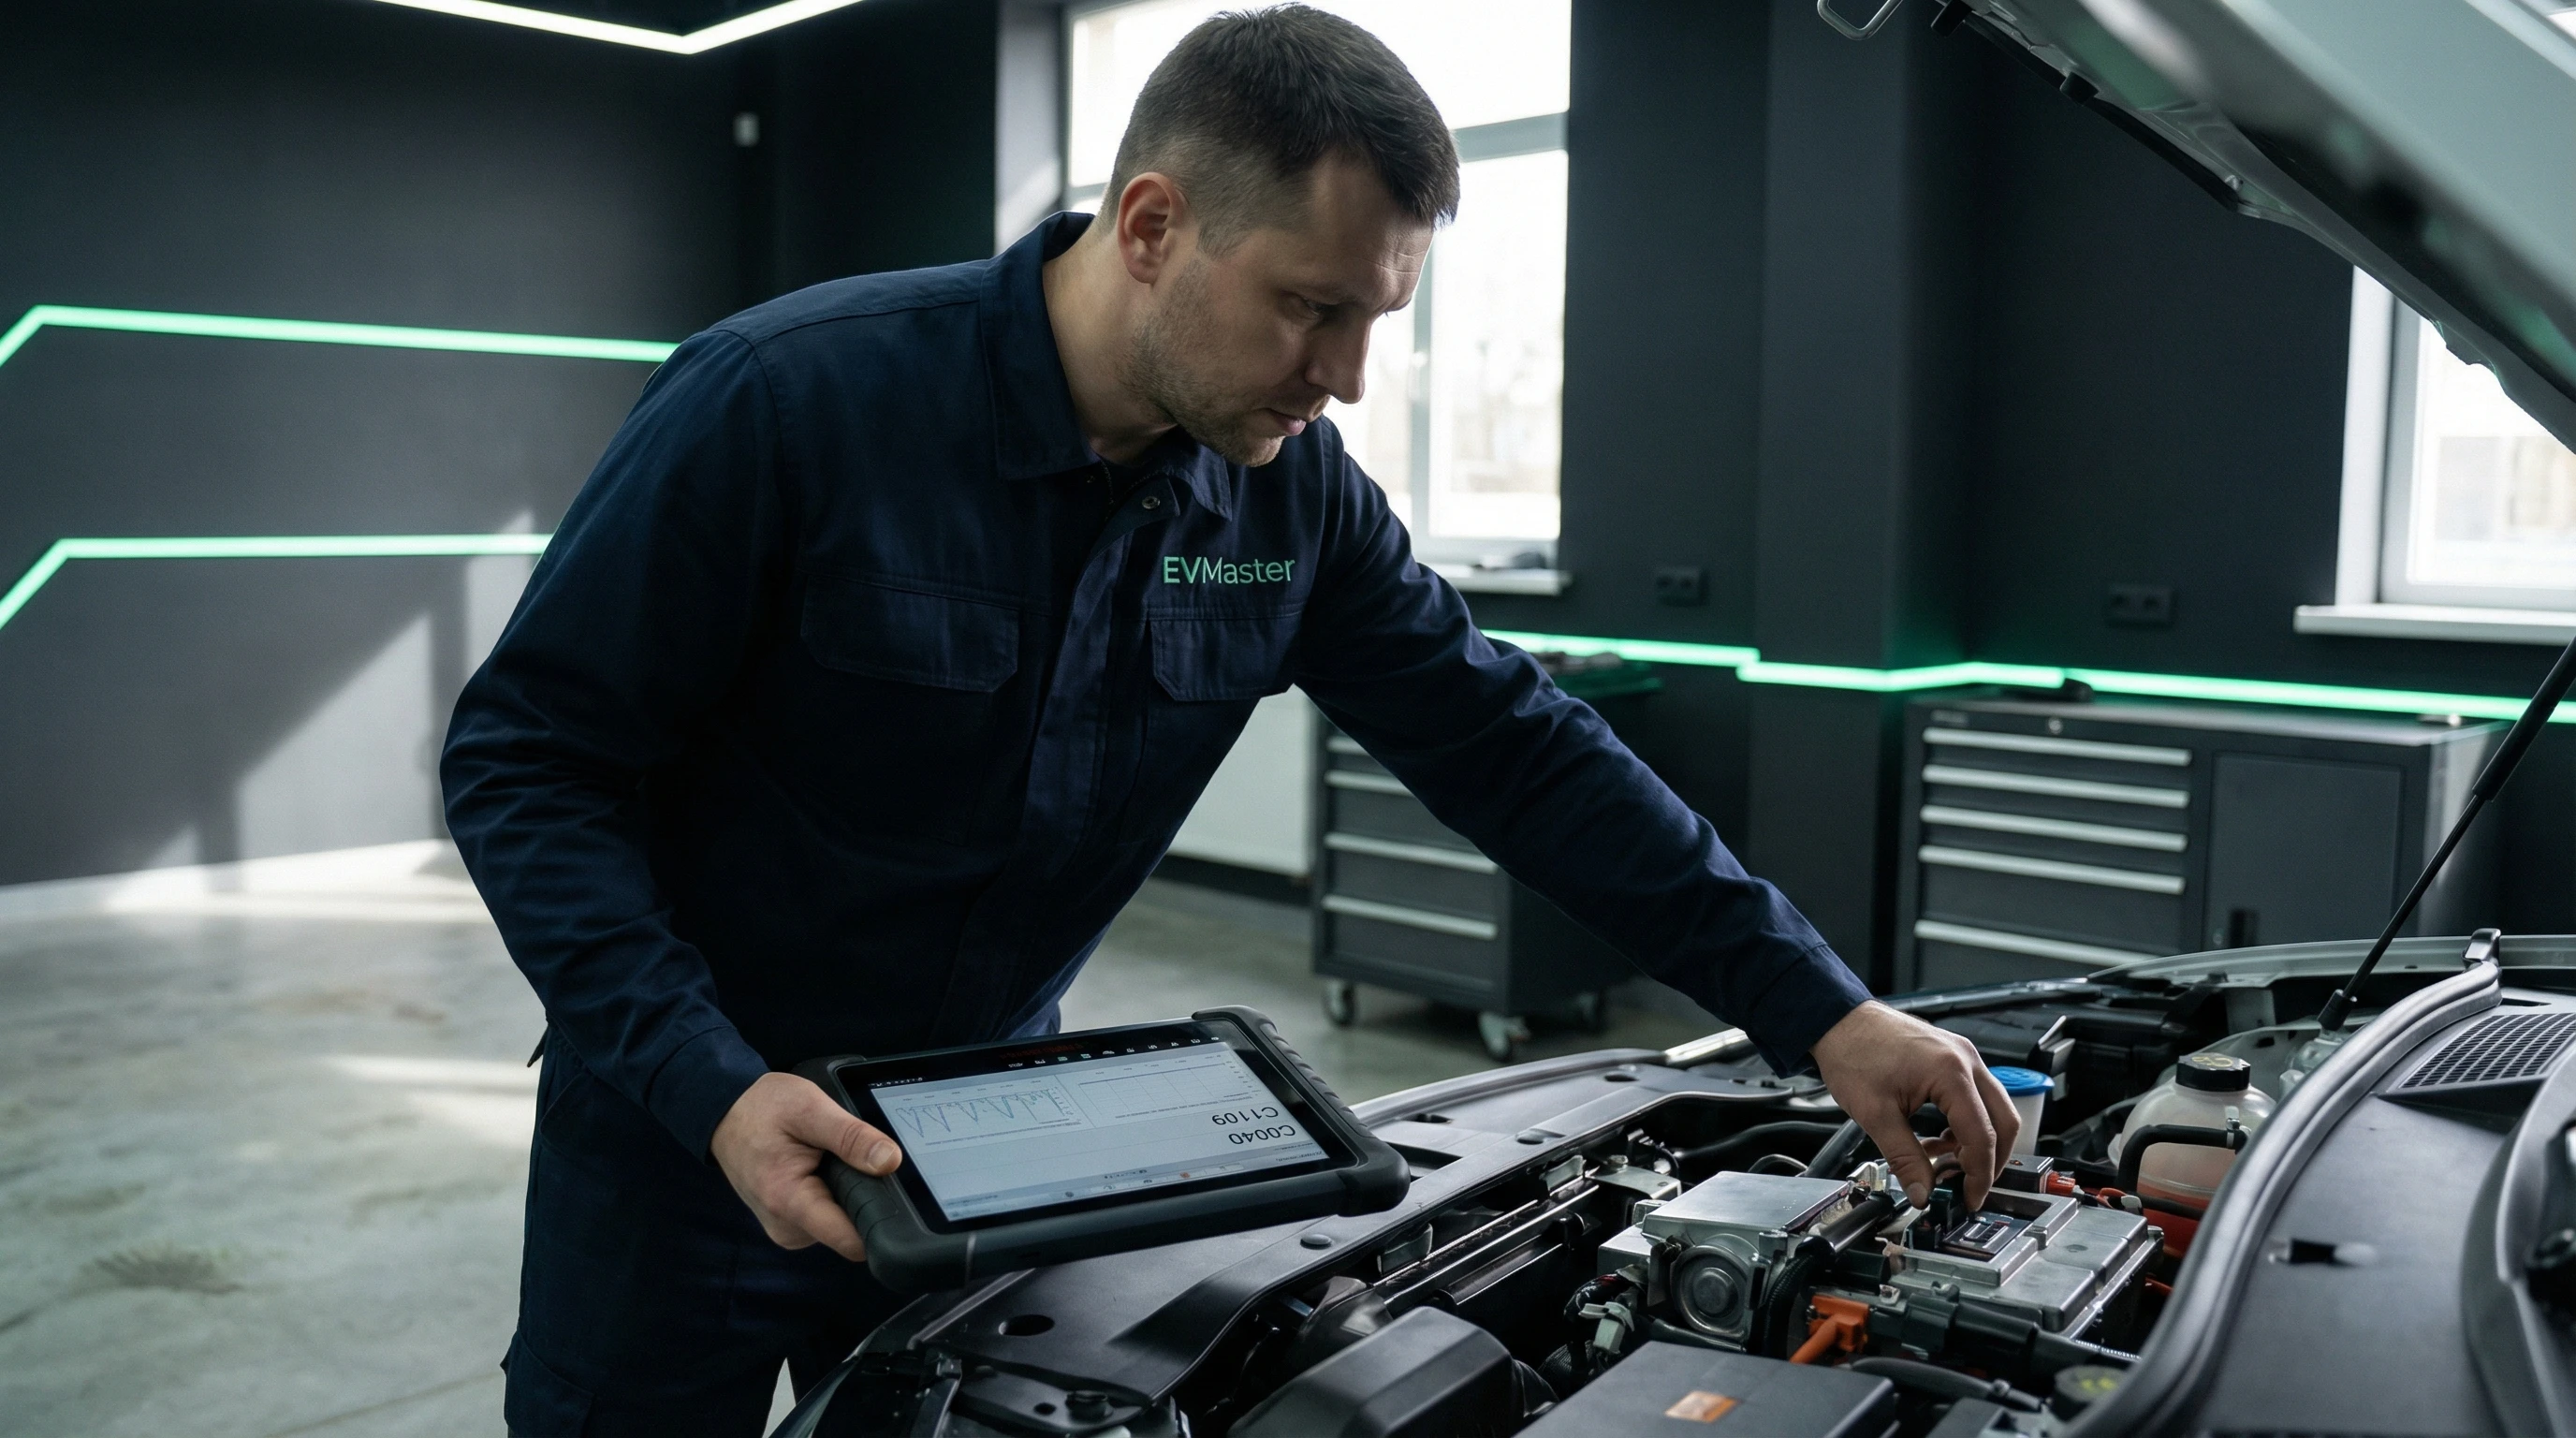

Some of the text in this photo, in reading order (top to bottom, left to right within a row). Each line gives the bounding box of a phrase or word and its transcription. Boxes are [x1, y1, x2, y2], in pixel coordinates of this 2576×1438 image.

[1164, 556, 1295, 584] EVMaster
[1211, 1107, 1279, 1125] C1109
[1228, 1124, 1296, 1145] C0040
